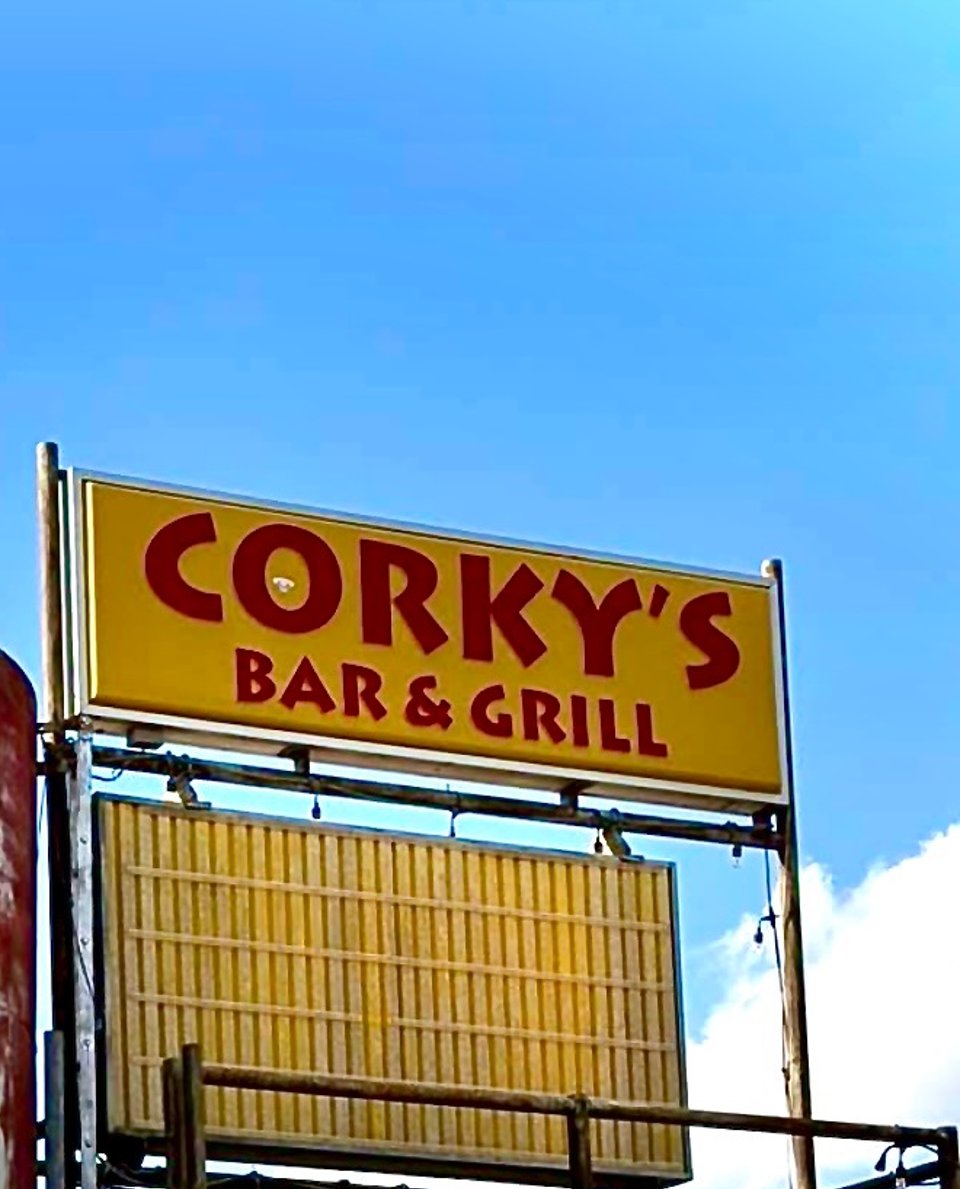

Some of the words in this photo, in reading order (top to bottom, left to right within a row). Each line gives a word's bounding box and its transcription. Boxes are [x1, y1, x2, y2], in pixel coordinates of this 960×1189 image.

[144, 511, 741, 691] CORKY'S
[234, 647, 388, 721] BAR
[404, 675, 454, 730] &
[470, 683, 668, 758] GRILL
